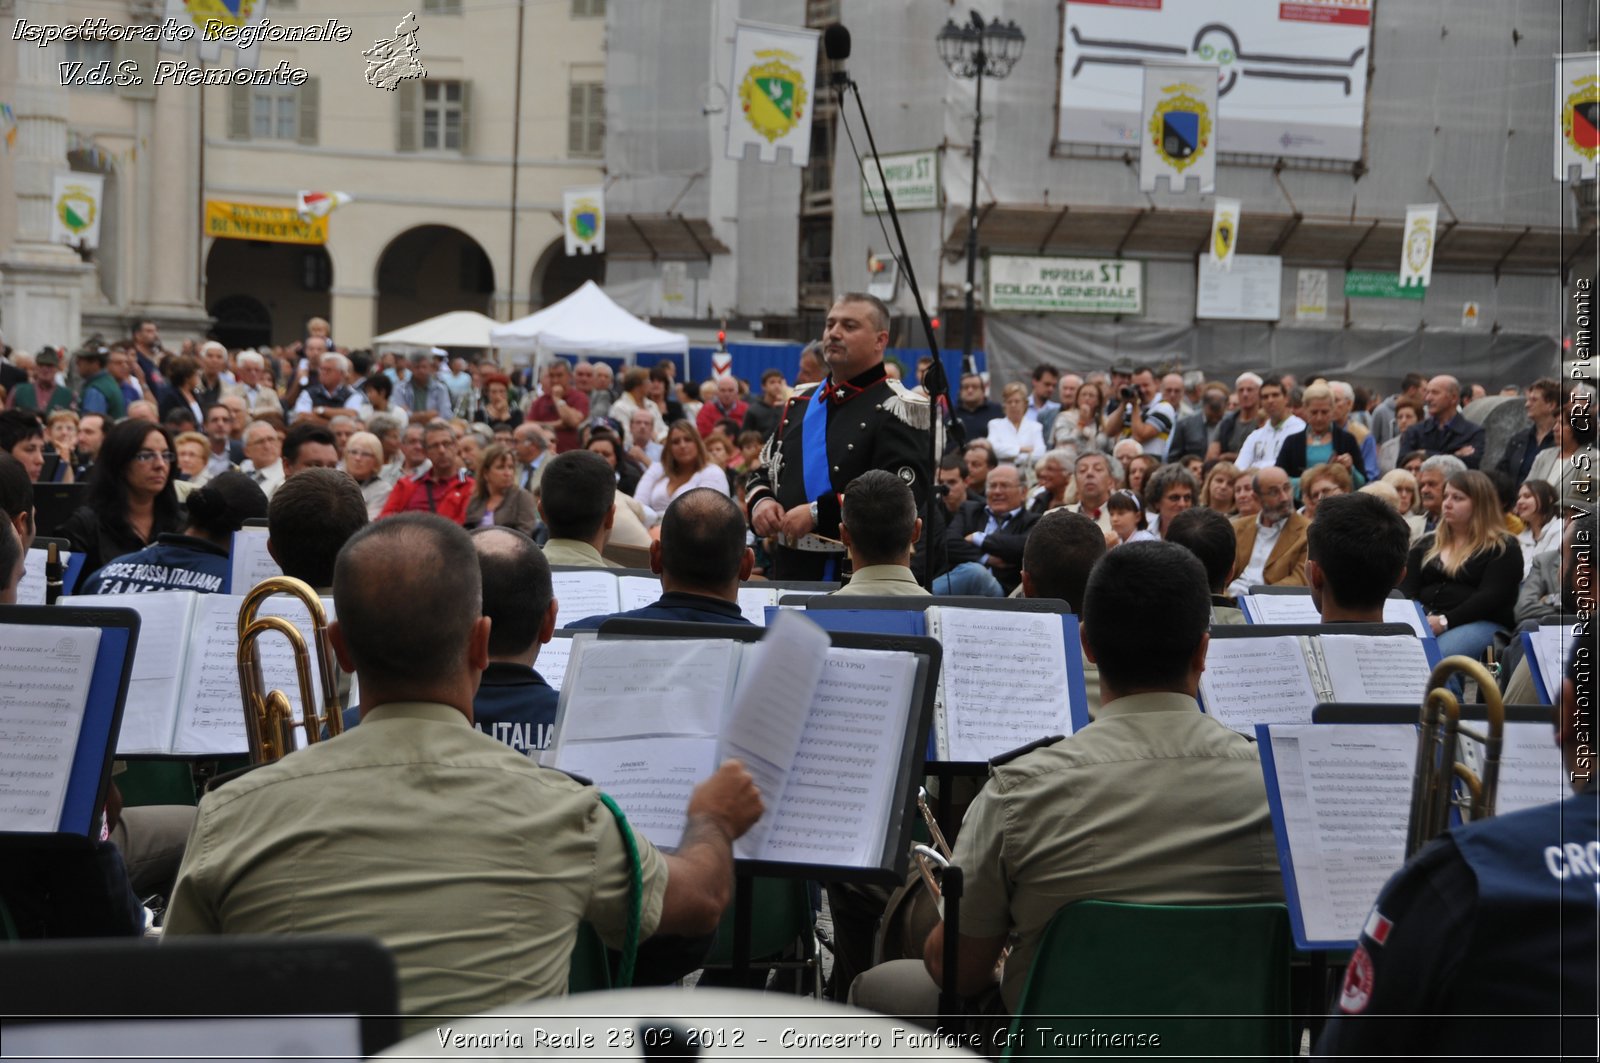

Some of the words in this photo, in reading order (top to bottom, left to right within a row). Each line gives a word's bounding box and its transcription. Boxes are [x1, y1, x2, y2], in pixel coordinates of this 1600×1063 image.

[1040, 268, 1095, 283] IMPRESA
[1100, 263, 1124, 283] ST
[994, 283, 1054, 296] EDILIZIA
[1057, 284, 1137, 298] GENERALE
[100, 562, 136, 579] CROCE
[131, 563, 168, 584] ROSSA
[167, 567, 223, 592] ITALIANA
